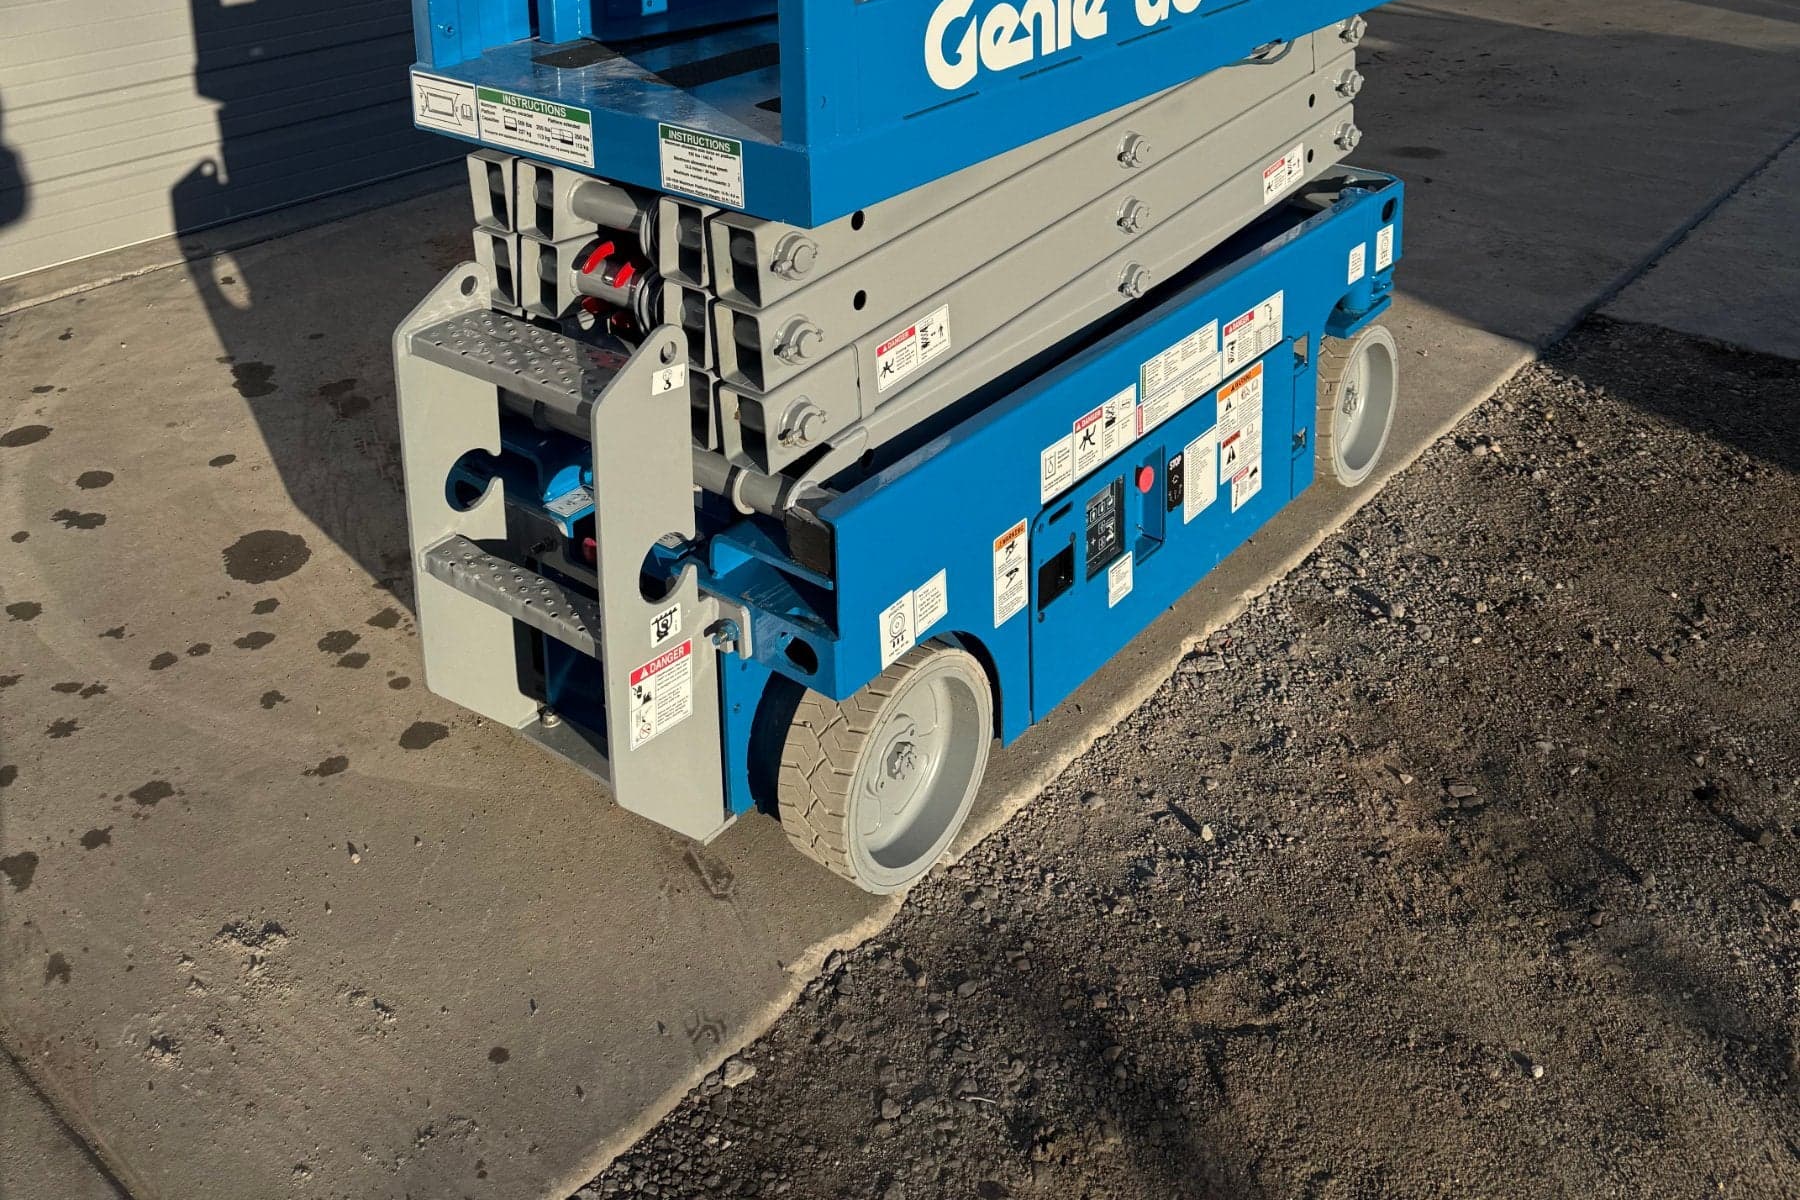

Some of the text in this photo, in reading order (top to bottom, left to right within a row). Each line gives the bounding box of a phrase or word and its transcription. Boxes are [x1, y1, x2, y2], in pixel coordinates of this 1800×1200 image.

[503, 94, 567, 118] INSTRUCTIONS
[668, 129, 731, 152] INSTRUCTIONS
[649, 646, 685, 674] DANGER
